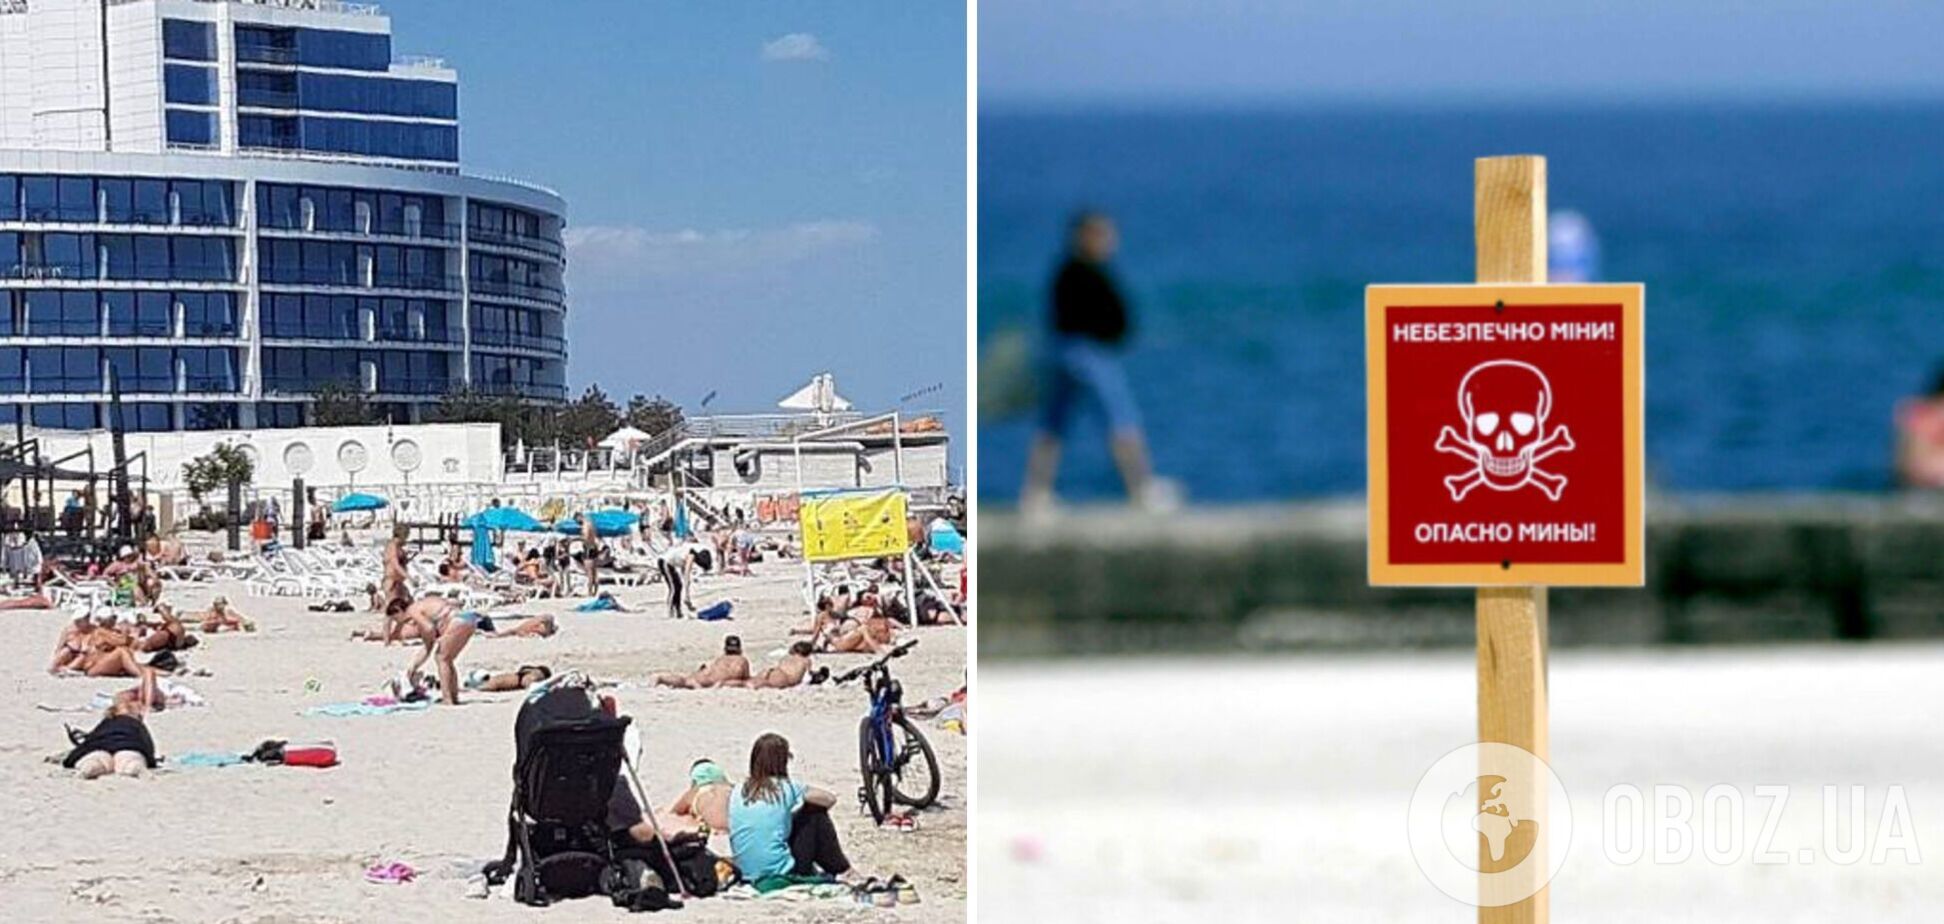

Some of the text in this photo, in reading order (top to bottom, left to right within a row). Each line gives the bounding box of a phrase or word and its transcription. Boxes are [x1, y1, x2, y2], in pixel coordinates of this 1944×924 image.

[1393, 322, 1615, 342] НЕБЕЗПЕЧНО МІНИ!
[1414, 523, 1595, 542] ОПАСНО МИНЫ!
